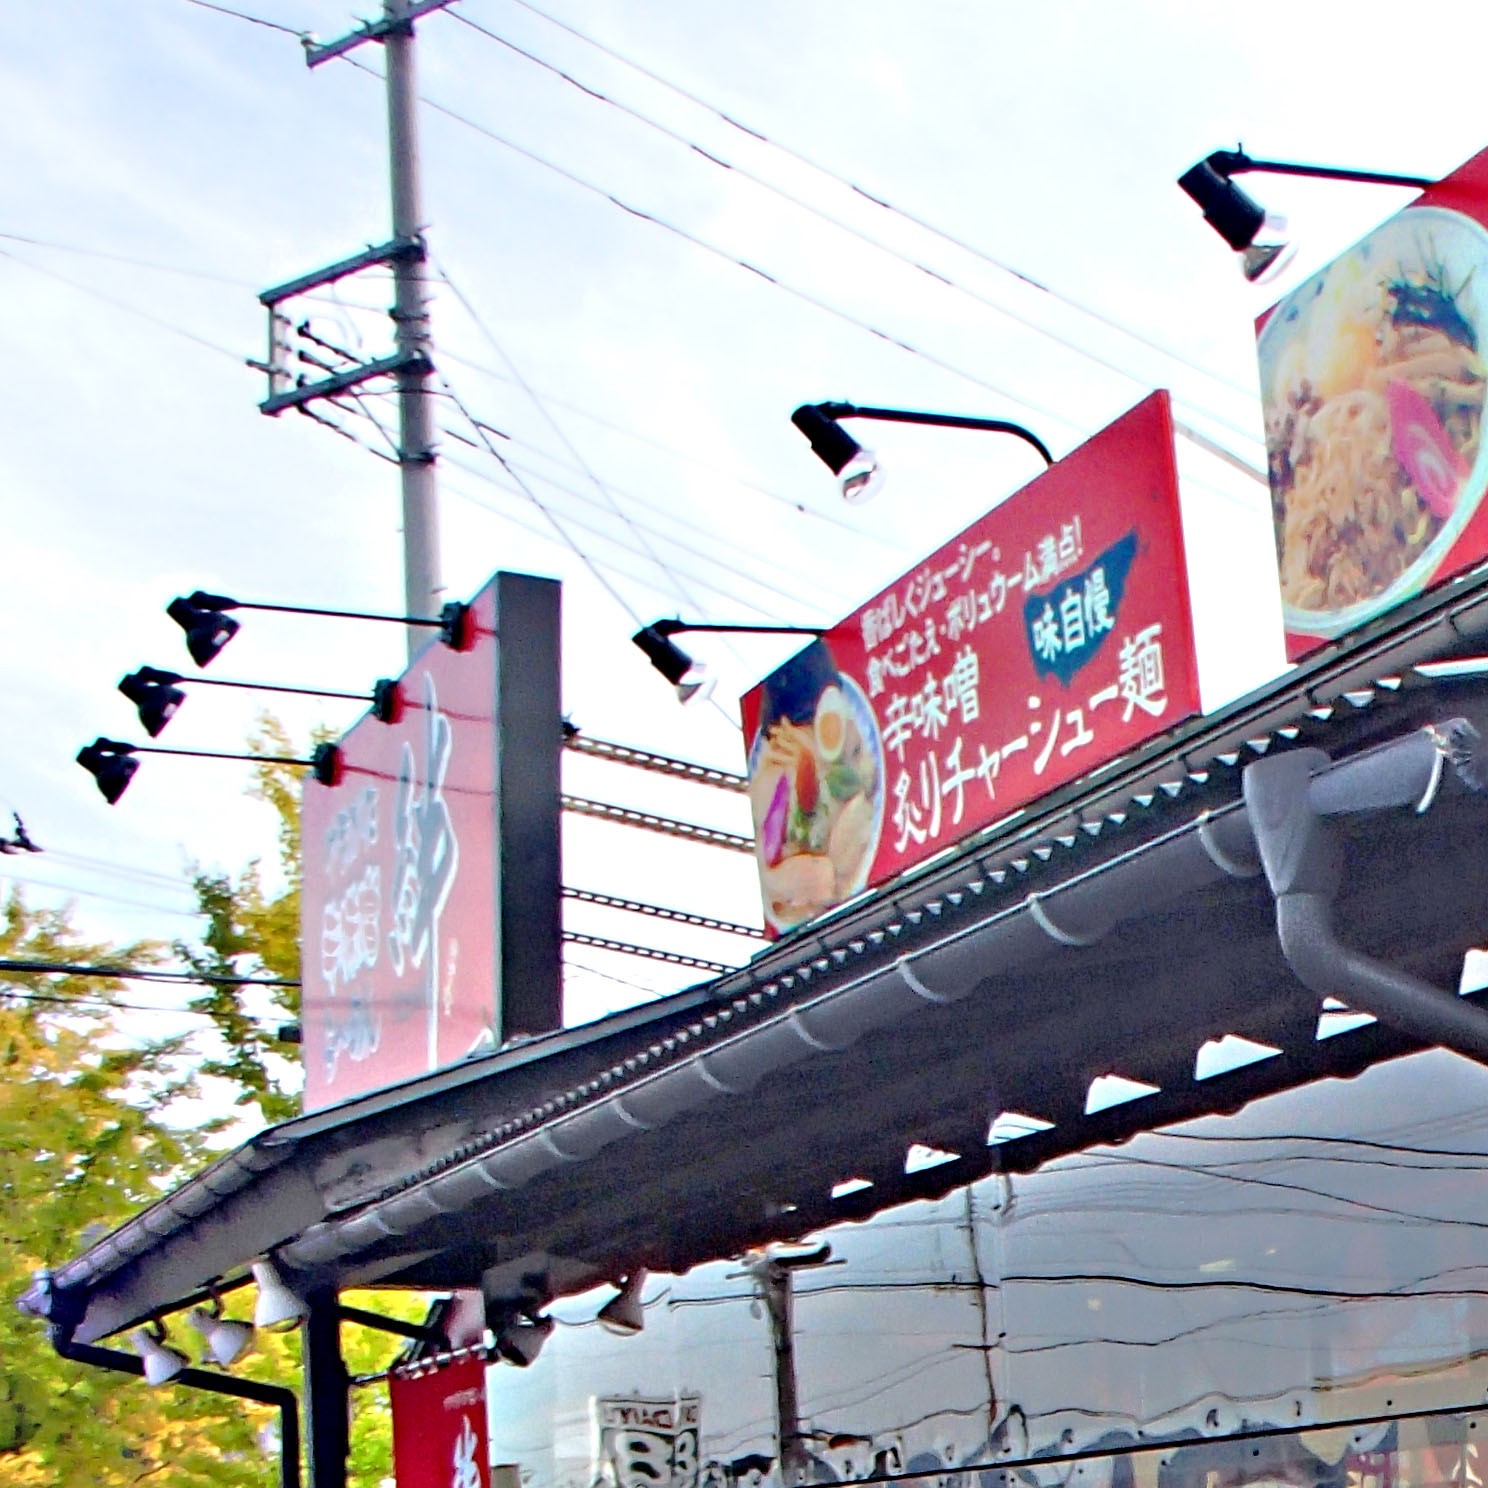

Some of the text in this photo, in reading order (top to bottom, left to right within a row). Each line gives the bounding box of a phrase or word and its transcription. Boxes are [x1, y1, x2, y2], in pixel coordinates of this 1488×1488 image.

[1032, 567, 1116, 662] 味自慢
[882, 644, 980, 762] 辛味噌
[893, 622, 1169, 853] 炙りチャーシュー麺
